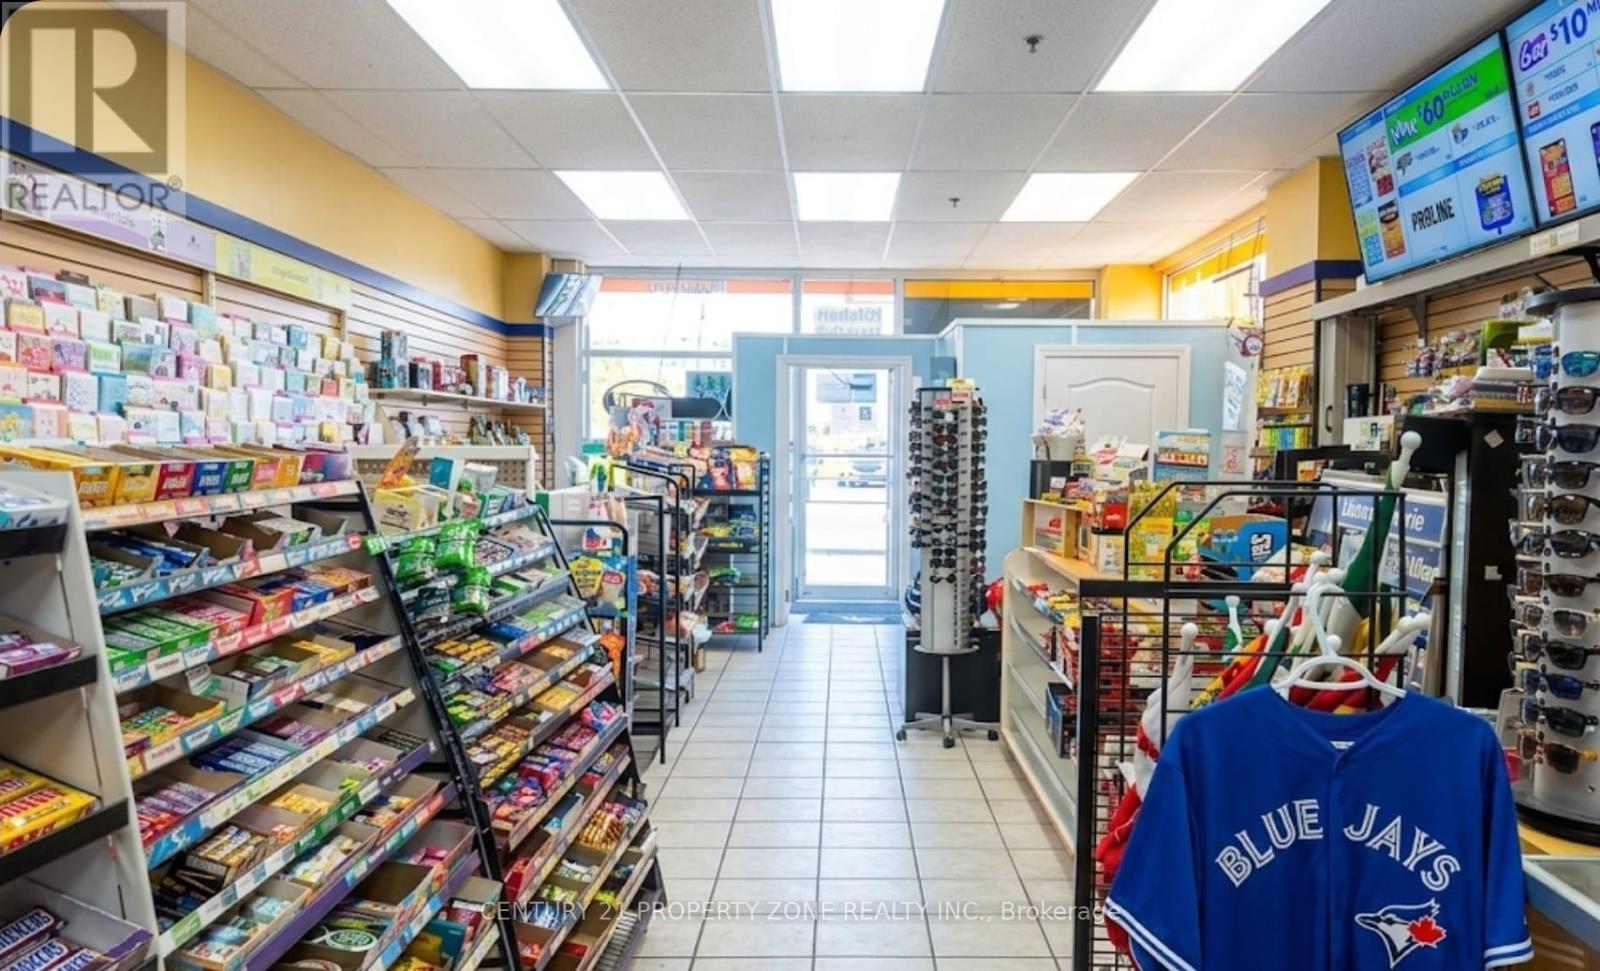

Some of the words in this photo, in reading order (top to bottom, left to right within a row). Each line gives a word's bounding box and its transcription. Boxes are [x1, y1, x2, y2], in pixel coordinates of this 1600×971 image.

[1550, 8, 1587, 45] $10
[1214, 798, 1324, 889] BLUE
[1343, 803, 1462, 892] JAYS
